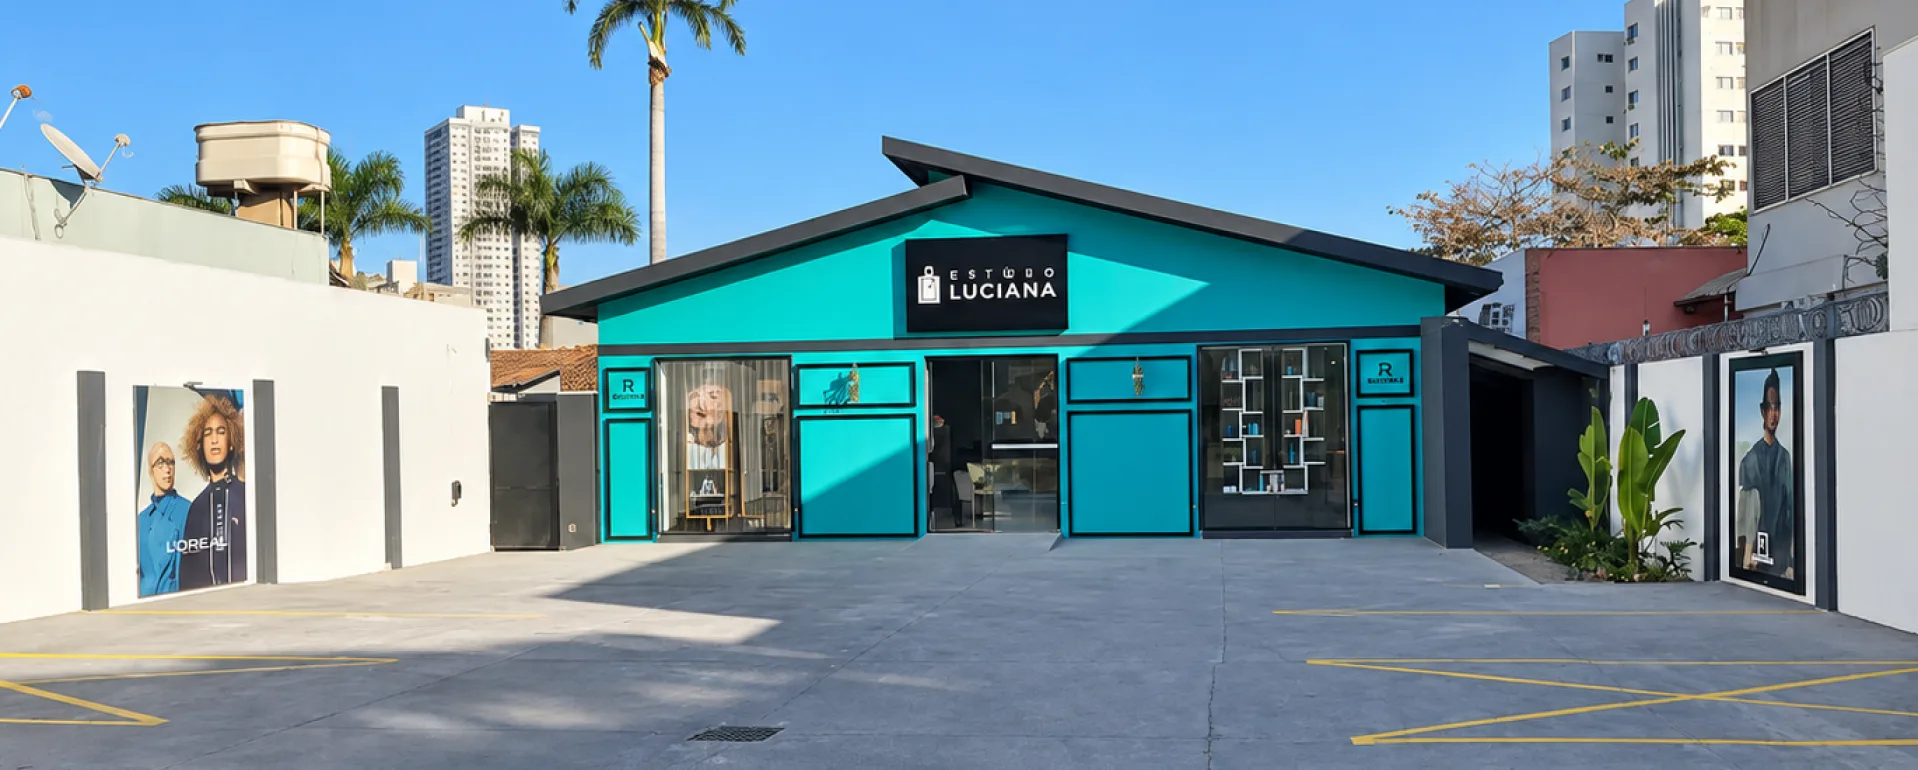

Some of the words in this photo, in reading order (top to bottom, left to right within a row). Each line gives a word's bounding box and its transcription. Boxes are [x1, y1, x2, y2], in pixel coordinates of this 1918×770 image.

[950, 282, 1057, 300] LUCIANA
[1378, 362, 1392, 376] R
[622, 378, 635, 393] R
